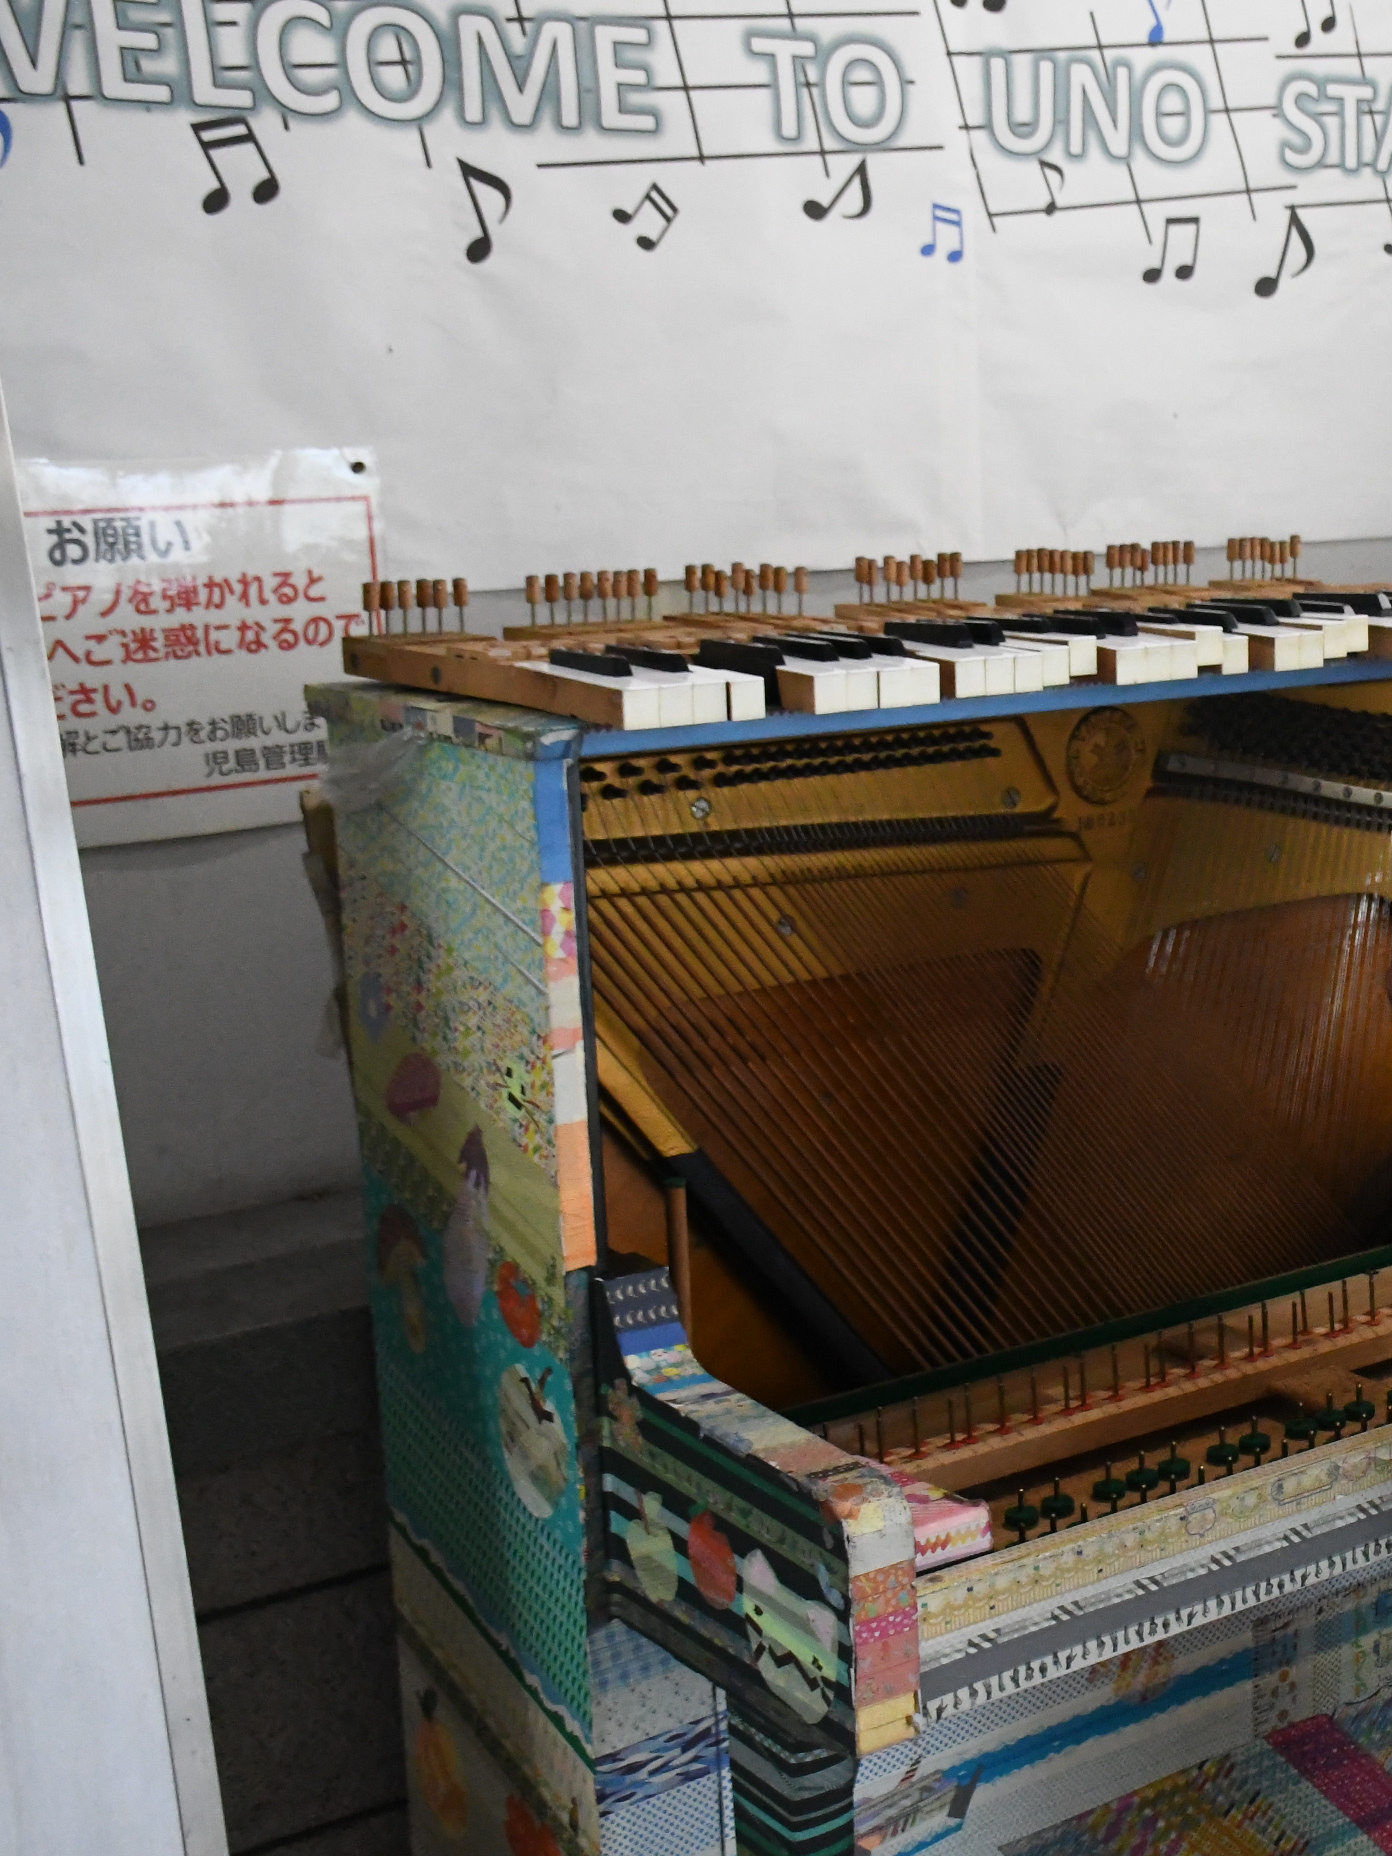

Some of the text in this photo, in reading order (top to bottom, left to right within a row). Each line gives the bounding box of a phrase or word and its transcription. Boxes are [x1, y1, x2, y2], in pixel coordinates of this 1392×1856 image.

[750, 36, 904, 145] TO
[988, 54, 1203, 163] UNO
[46, 517, 191, 567] お願い
